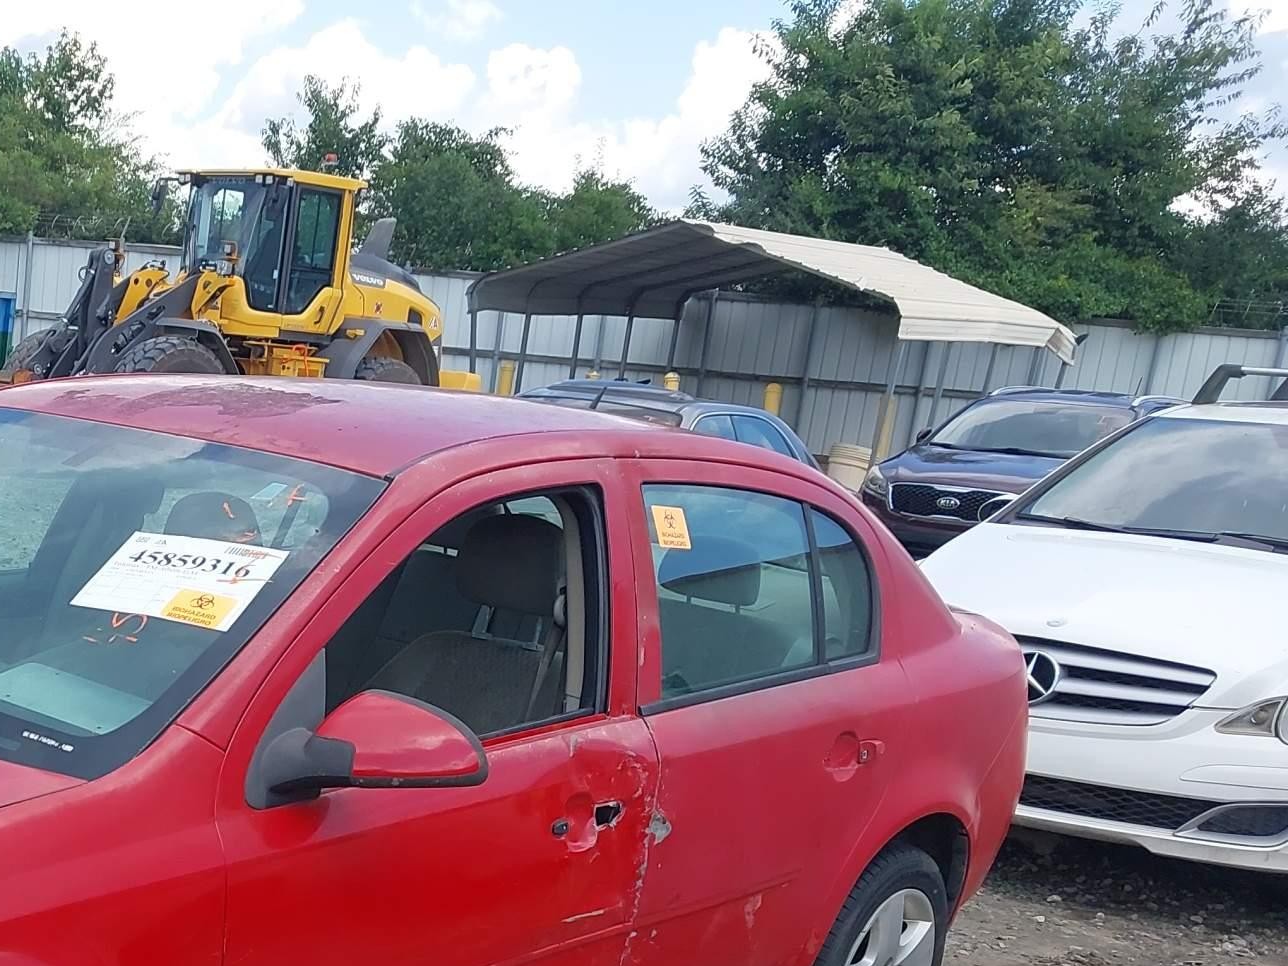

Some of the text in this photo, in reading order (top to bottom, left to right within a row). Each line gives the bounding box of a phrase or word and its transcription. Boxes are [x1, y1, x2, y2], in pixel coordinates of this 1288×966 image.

[352, 273, 384, 286] VOLVO
[939, 498, 956, 508] KIA
[129, 549, 251, 579] 45859316
[171, 605, 217, 620] BIOHAZARD
